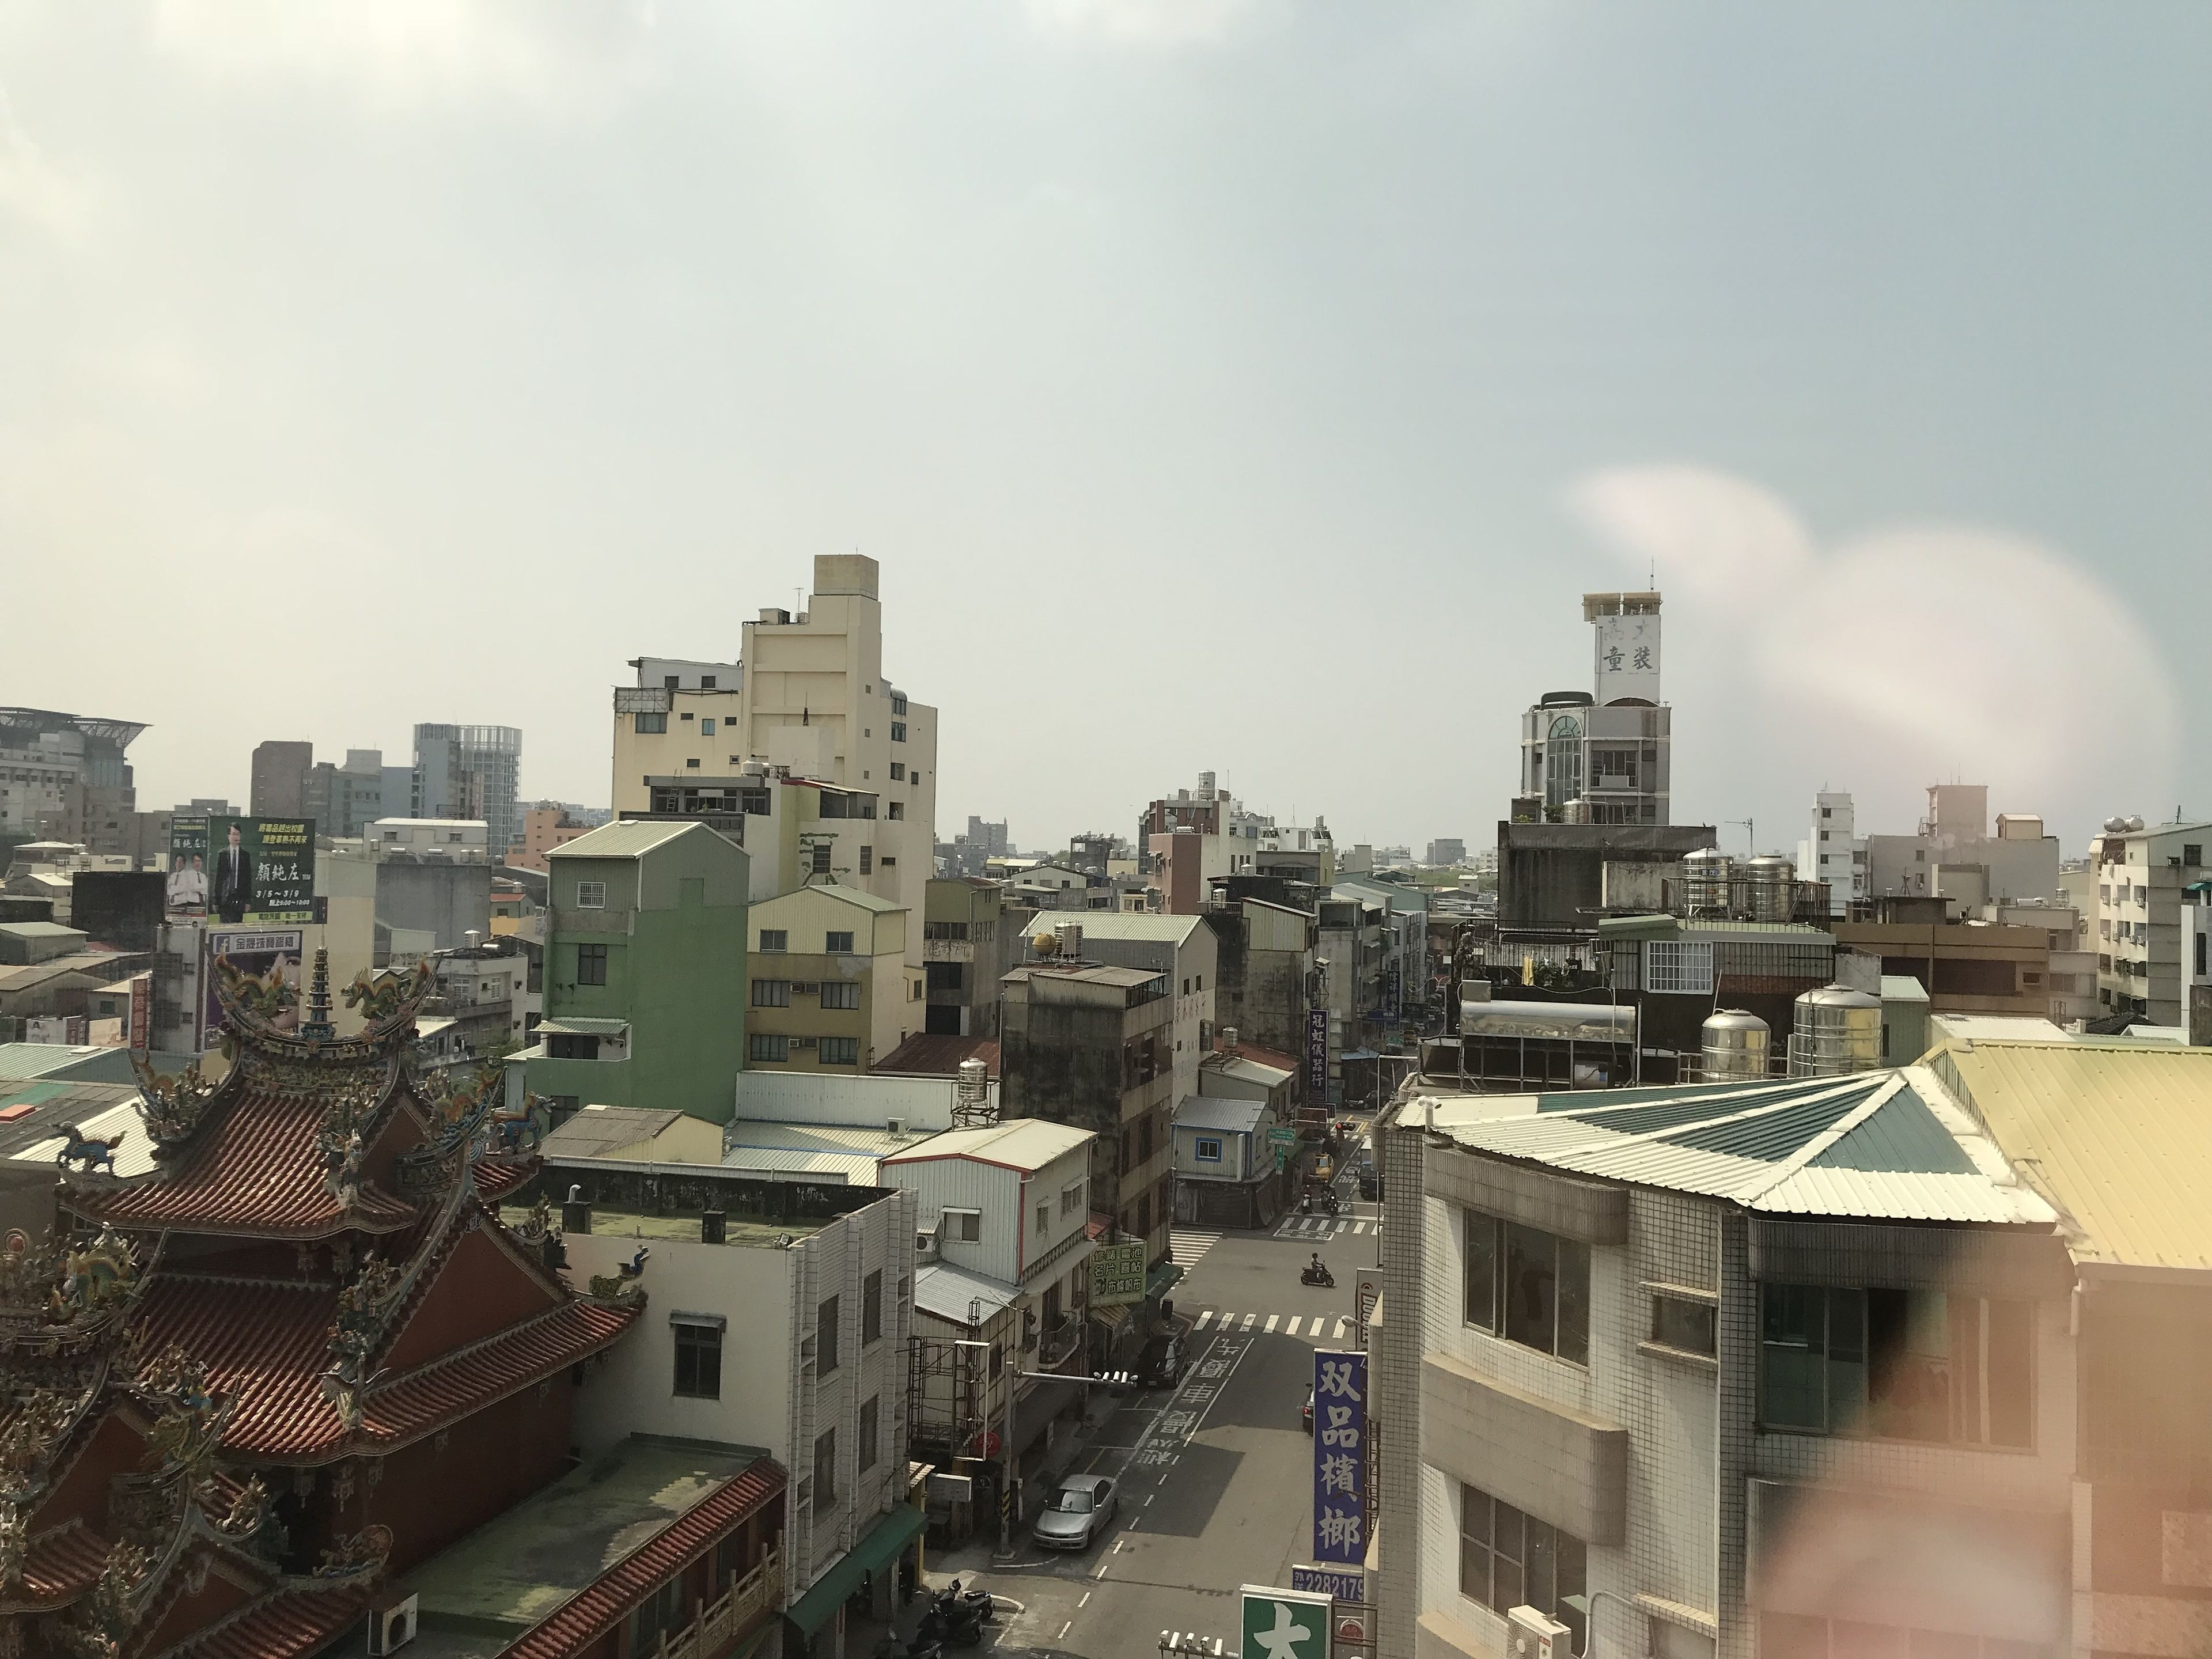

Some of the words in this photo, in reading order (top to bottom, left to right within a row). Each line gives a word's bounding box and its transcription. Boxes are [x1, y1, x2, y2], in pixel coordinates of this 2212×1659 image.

[1603, 646, 1653, 672] 童裝
[1311, 1014, 1324, 1087] 冠虹儀器行
[1094, 1263, 1116, 1277] 名片
[1120, 1260, 1142, 1274] 喜帖
